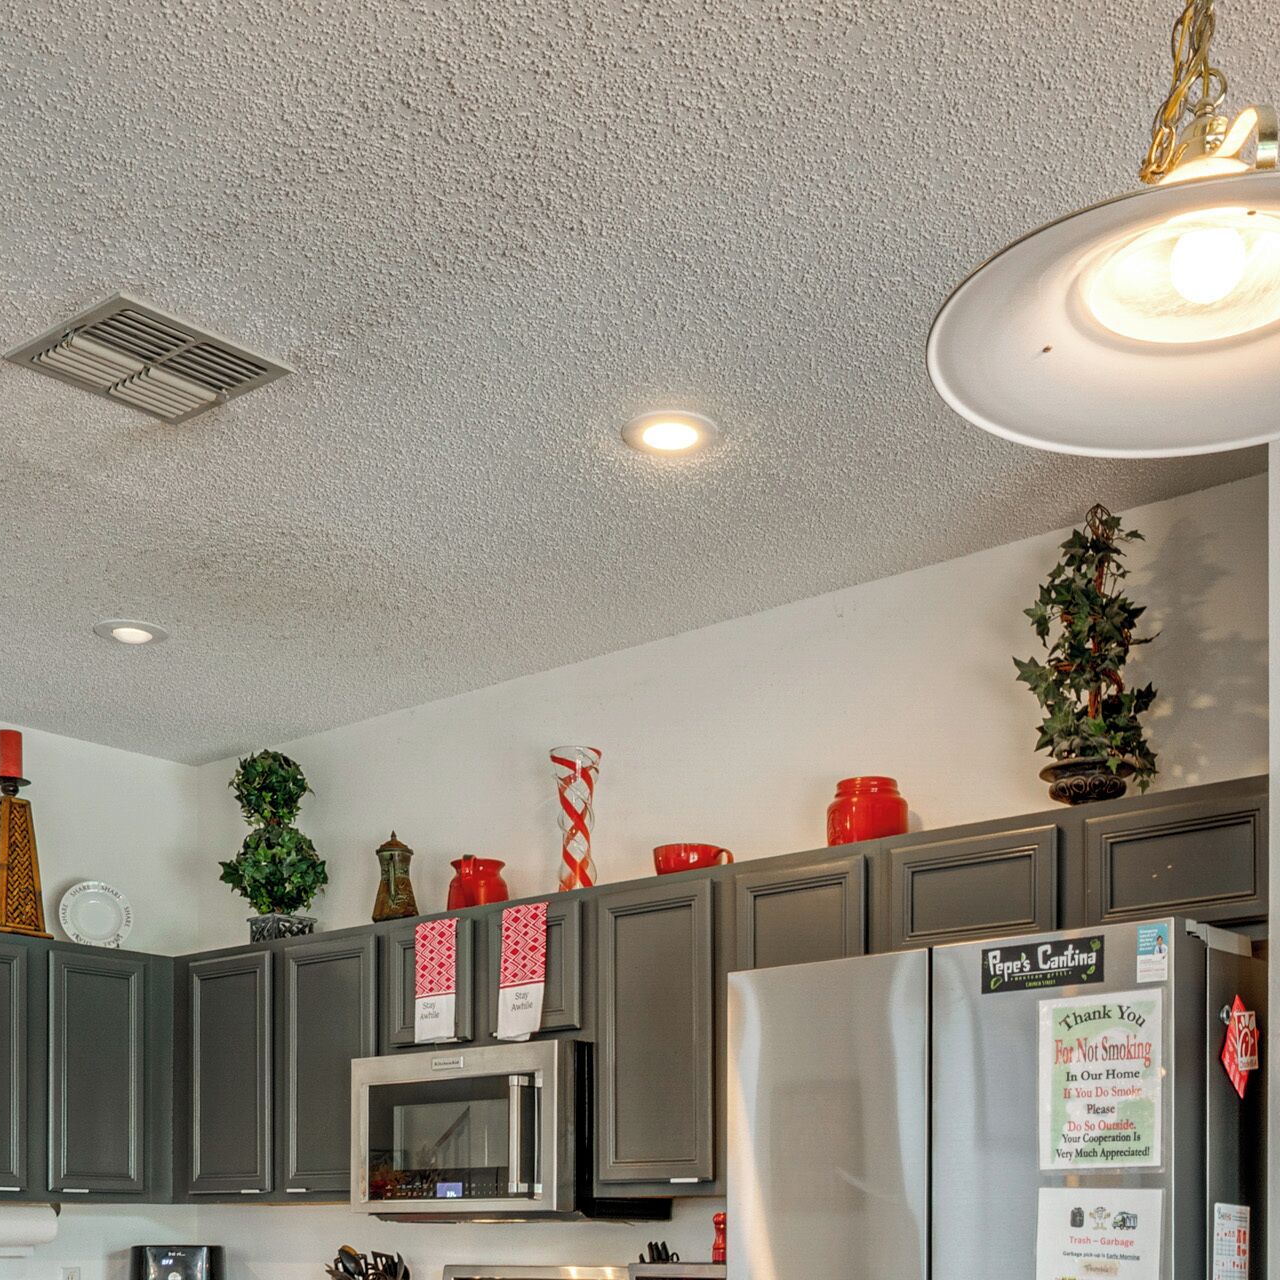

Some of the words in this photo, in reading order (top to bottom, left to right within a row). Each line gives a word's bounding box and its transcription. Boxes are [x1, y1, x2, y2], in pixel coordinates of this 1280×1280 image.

[988, 950, 1031, 982] Pepe's
[1037, 944, 1096, 970] Cantina
[514, 992, 529, 1001] Stay
[422, 1001, 436, 1011] Stay
[511, 1001, 533, 1012] Awhile
[1059, 1005, 1112, 1031] Thank
[1117, 1005, 1146, 1027] You
[1055, 1039, 1074, 1064] For
[1076, 1037, 1099, 1063] Not
[1101, 1034, 1152, 1068] Smoking
[1066, 1072, 1077, 1082] In
[1081, 1071, 1103, 1080] Our
[1106, 1069, 1140, 1079] Home
[1063, 1088, 1072, 1099] If
[1075, 1088, 1092, 1097] You
[1095, 1087, 1109, 1097] Do
[1112, 1085, 1142, 1097] Smoke
[1087, 1104, 1115, 1114] Please
[1068, 1121, 1081, 1131] Do
[1084, 1120, 1095, 1131] So
[1098, 1119, 1136, 1130] Outside.
[1062, 1134, 1081, 1143] Your
[1083, 1132, 1131, 1145] Cooperation
[1133, 1132, 1141, 1141] Is
[1056, 1149, 1073, 1160] Very
[1075, 1148, 1097, 1158] Much
[1100, 1146, 1150, 1160] Appreciated!
[1069, 1236, 1091, 1244] Trash
[1100, 1237, 1134, 1248] Garbage
